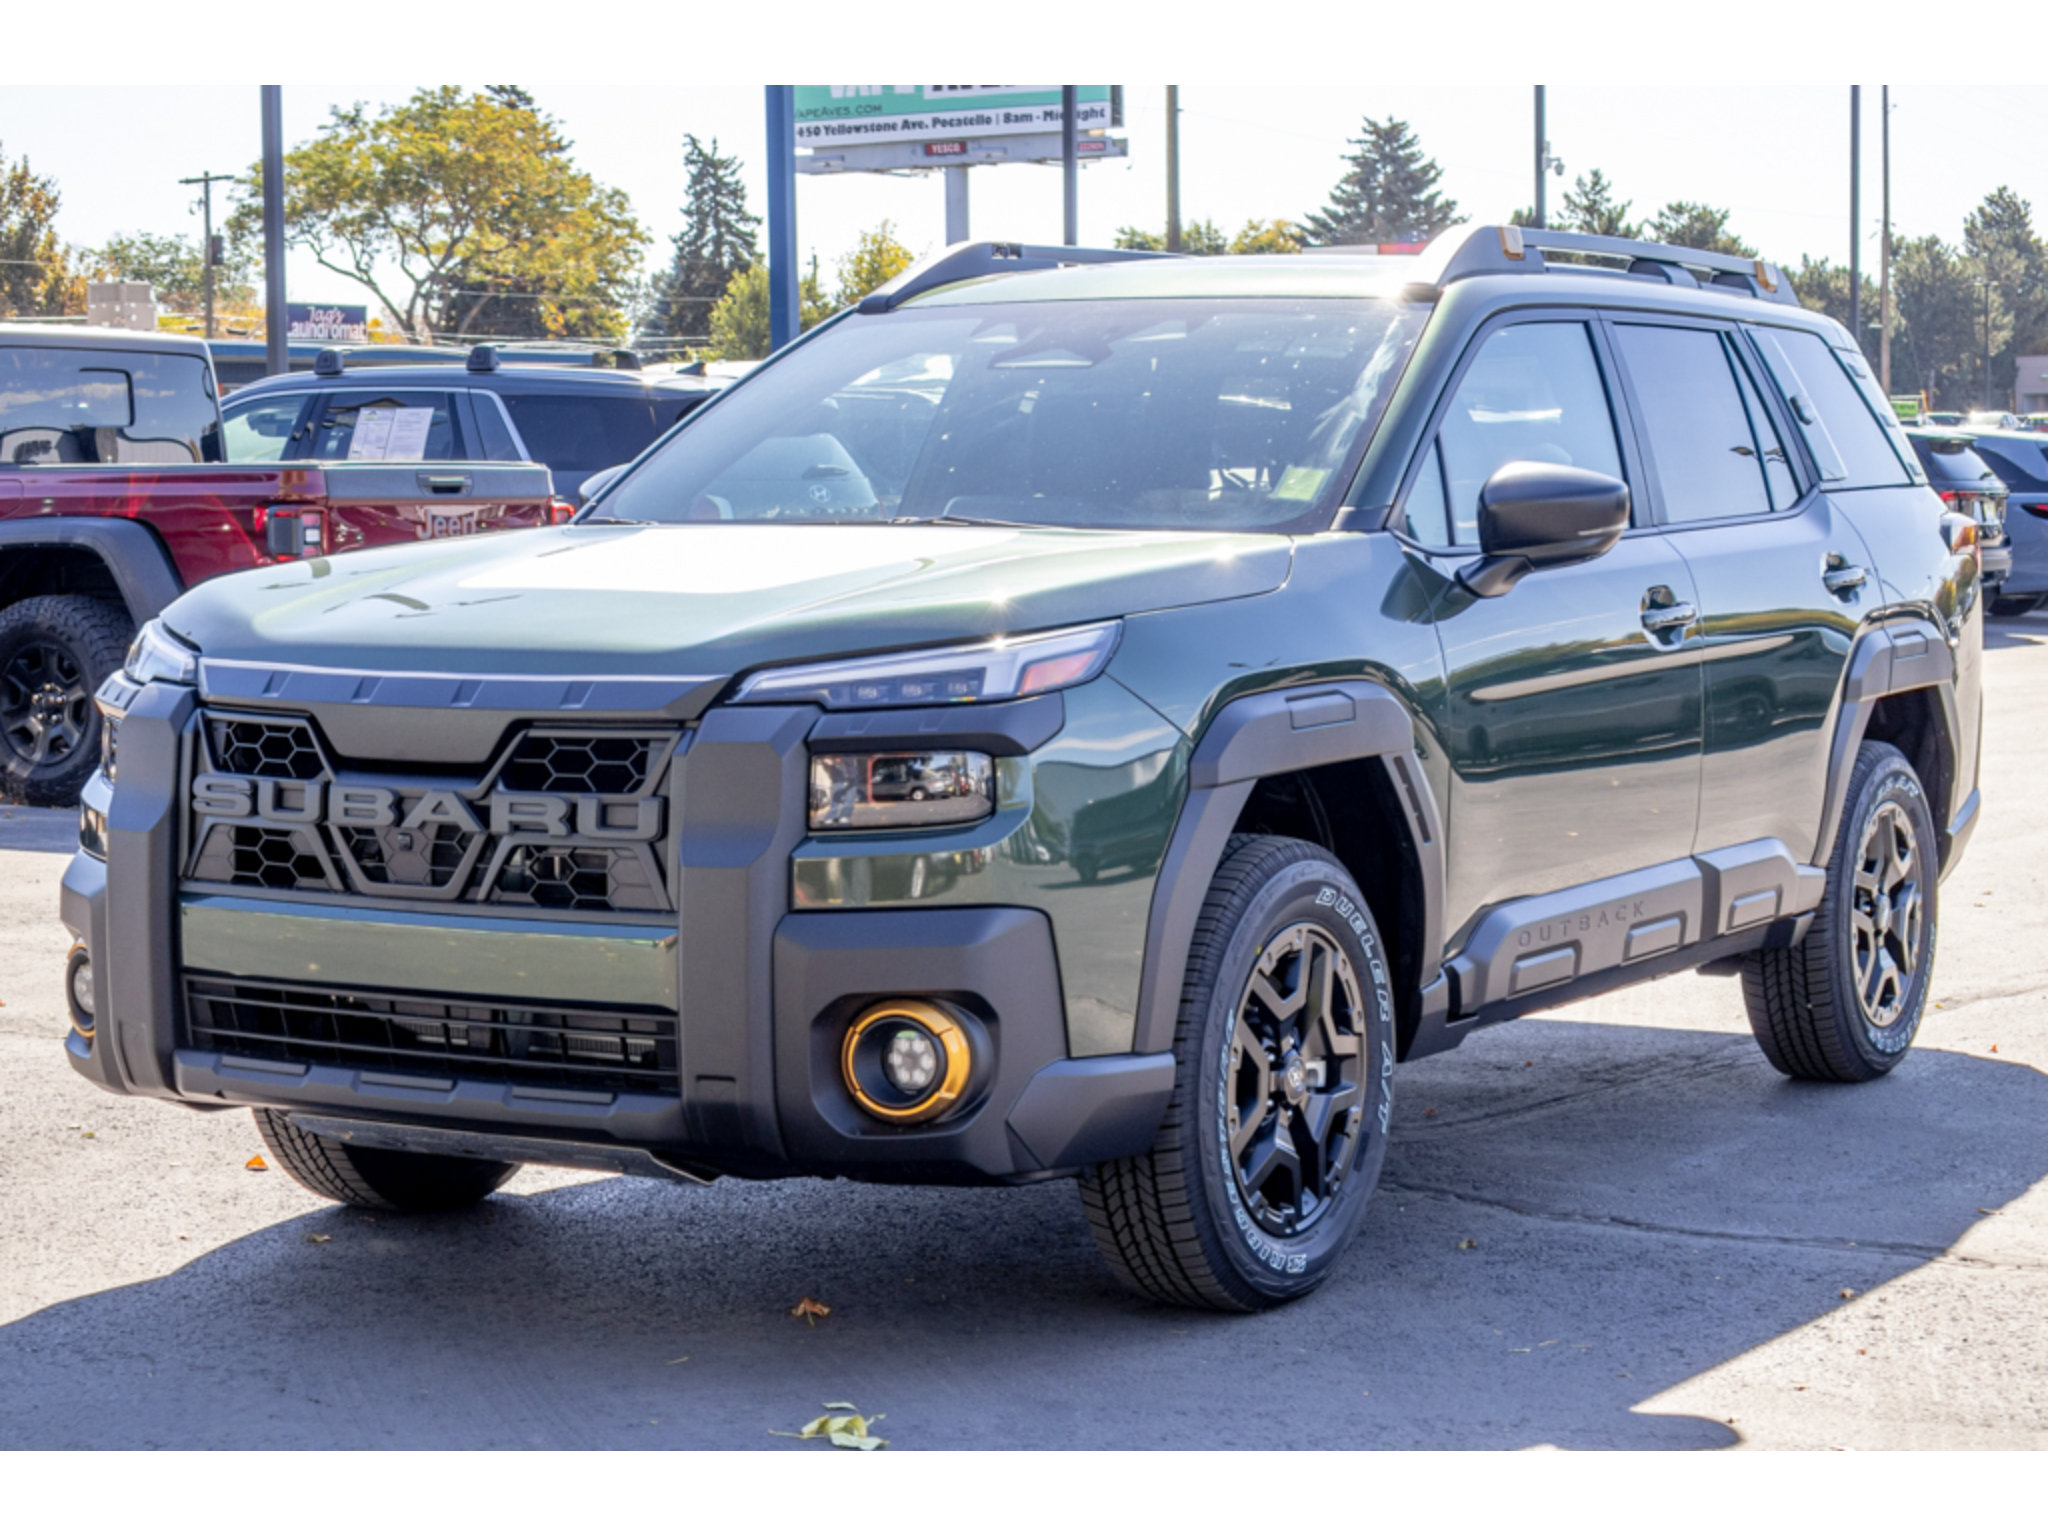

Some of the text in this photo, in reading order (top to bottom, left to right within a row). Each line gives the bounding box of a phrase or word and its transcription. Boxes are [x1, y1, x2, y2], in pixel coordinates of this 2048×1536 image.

[823, 121, 898, 136] Yellowstone
[901, 118, 929, 131] Ave.
[932, 114, 992, 129] Pocatello
[1003, 111, 1033, 123] 8am
[192, 773, 666, 842] SUBARU
[1517, 900, 1645, 948] OUTBACK
[1315, 884, 1391, 1023] DUELER
